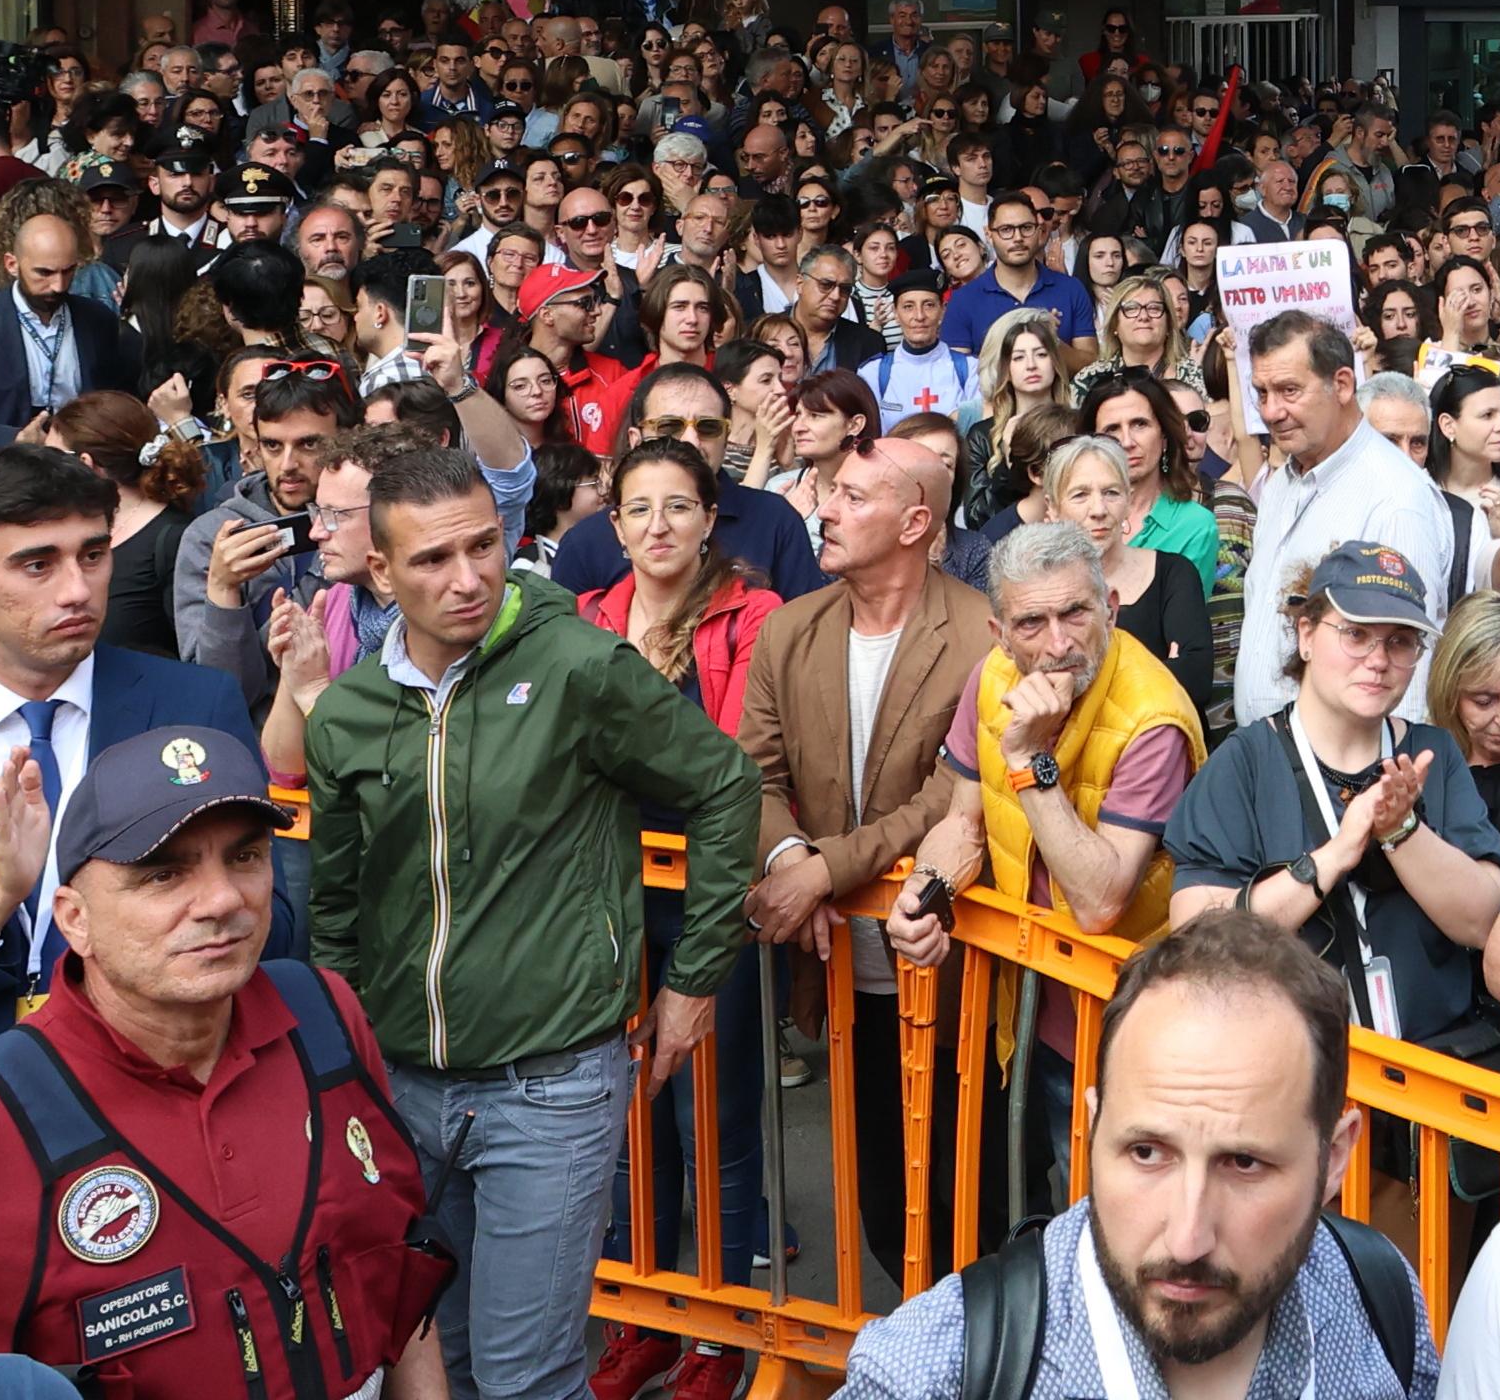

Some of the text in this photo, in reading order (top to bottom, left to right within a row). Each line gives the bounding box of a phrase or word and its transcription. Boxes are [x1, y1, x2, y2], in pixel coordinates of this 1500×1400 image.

[1221, 258, 1245, 278] LA
[1309, 250, 1332, 269] UN
[1223, 281, 1331, 306] FATTO UMANO
[79, 1184, 125, 1219] SEZIONE DI
[97, 1212, 139, 1244] PALERMO
[99, 1281, 170, 1314] OPERATORE
[85, 1294, 189, 1338] SANICOLA S.C.
[133, 1316, 174, 1339] POSITIVO
